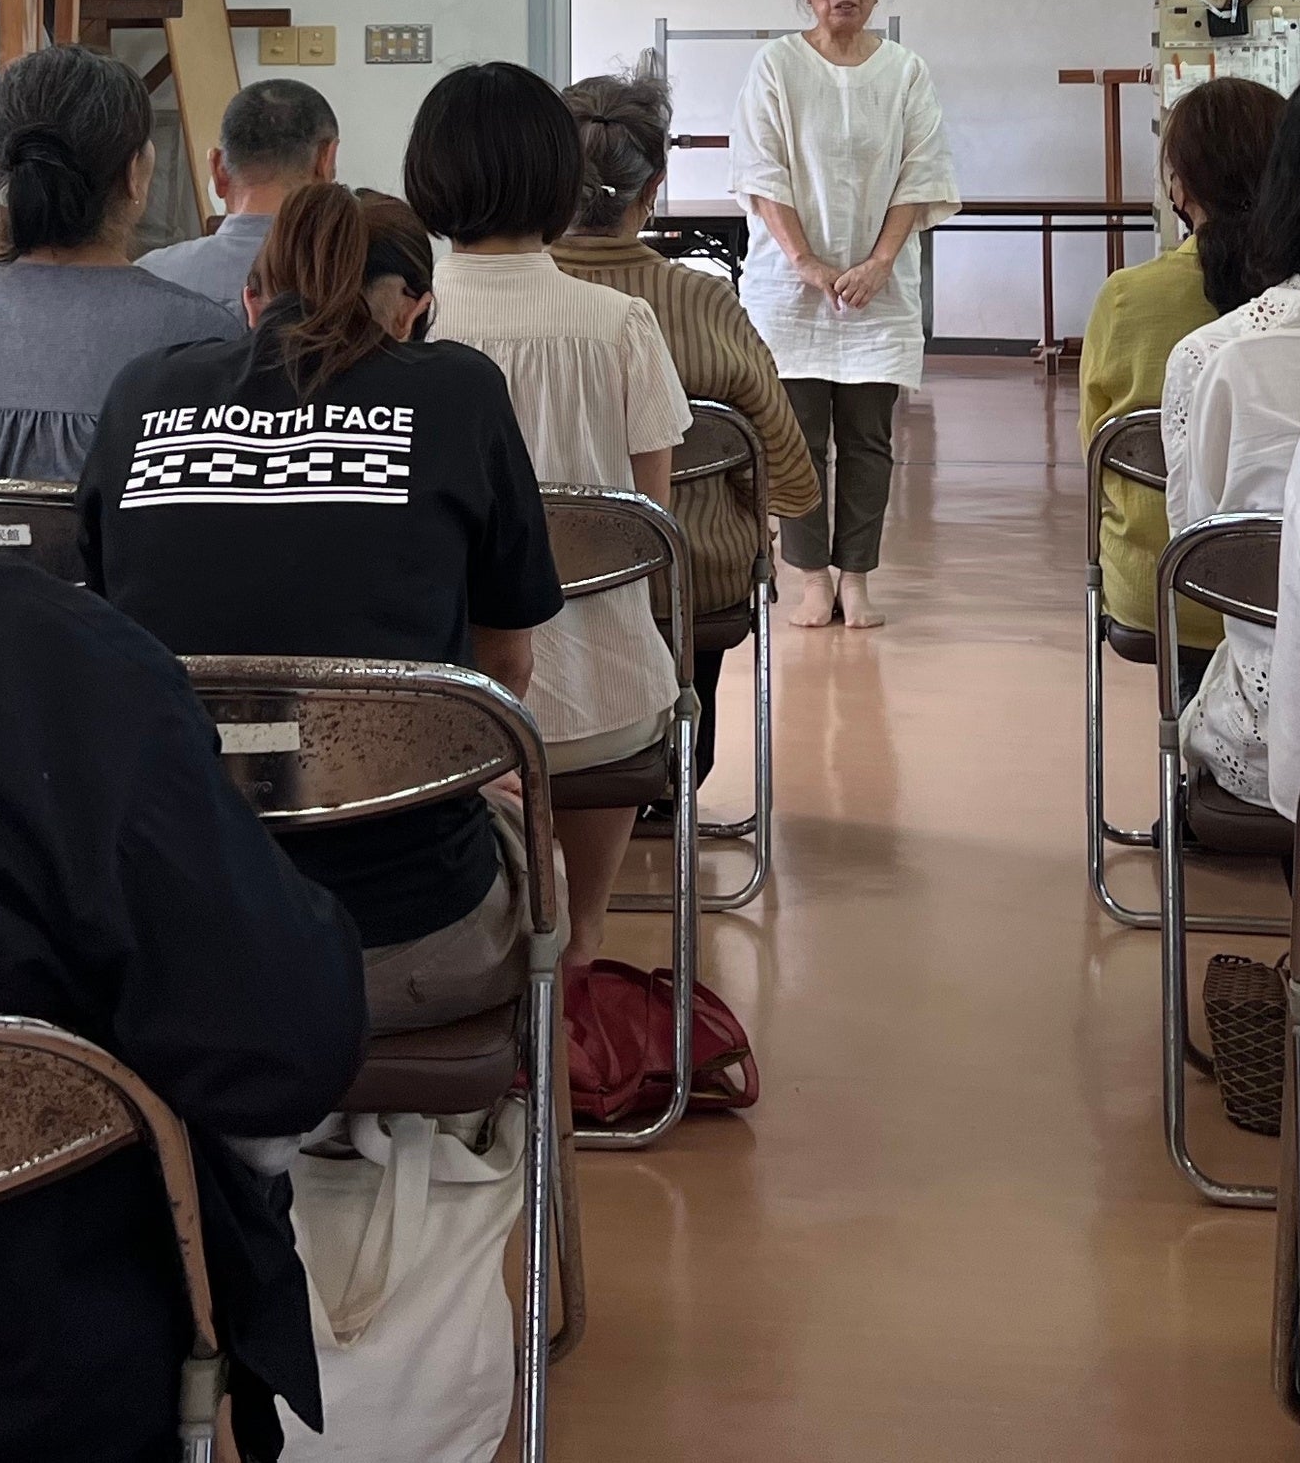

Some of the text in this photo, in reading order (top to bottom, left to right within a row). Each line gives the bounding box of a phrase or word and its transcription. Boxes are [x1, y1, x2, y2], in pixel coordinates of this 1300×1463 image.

[141, 403, 414, 437] THE NORTH FACE
